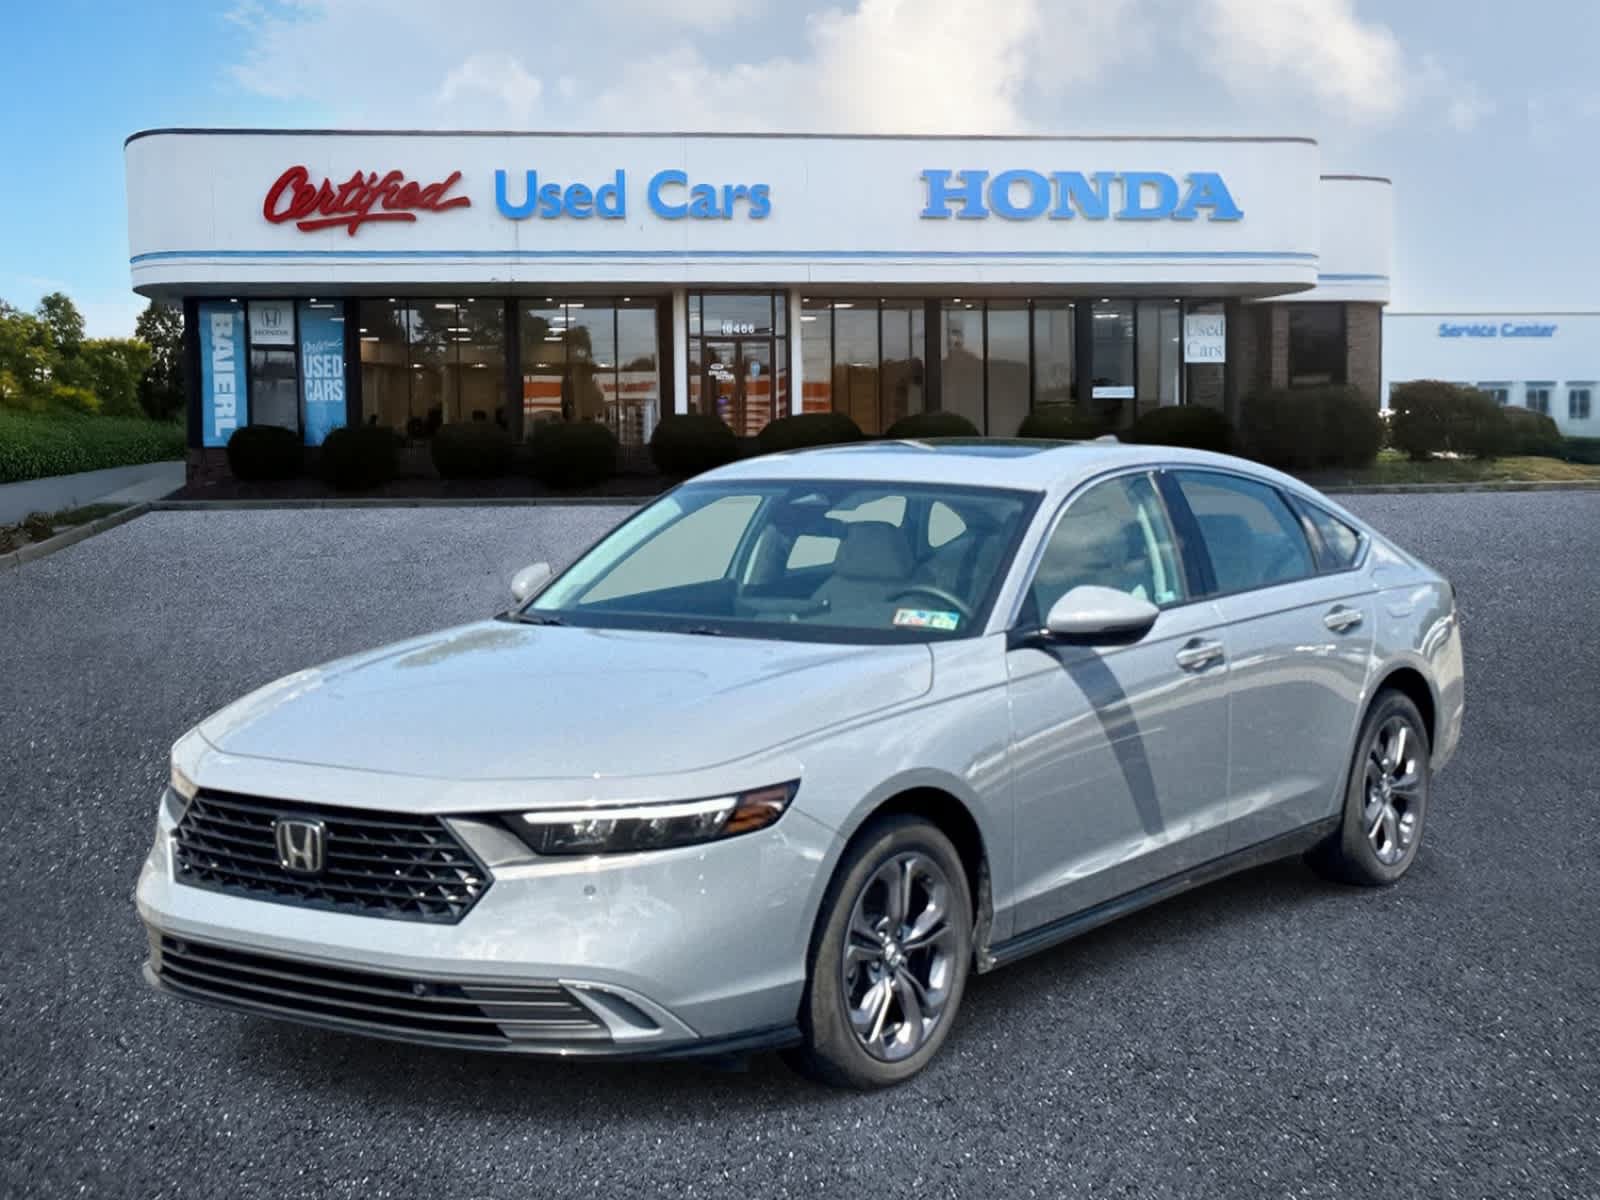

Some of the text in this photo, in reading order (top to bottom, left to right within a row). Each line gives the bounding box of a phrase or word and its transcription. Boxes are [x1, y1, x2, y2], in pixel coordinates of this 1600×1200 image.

[263, 165, 771, 236] Certified Used Cars
[920, 169, 1244, 221] HONDA
[1186, 318, 1224, 337] Used
[1439, 323, 1557, 337] Service Center
[1186, 341, 1223, 358] Cars
[211, 313, 236, 437] BAIERL
[303, 355, 344, 378] USED
[304, 380, 344, 402] CARS
